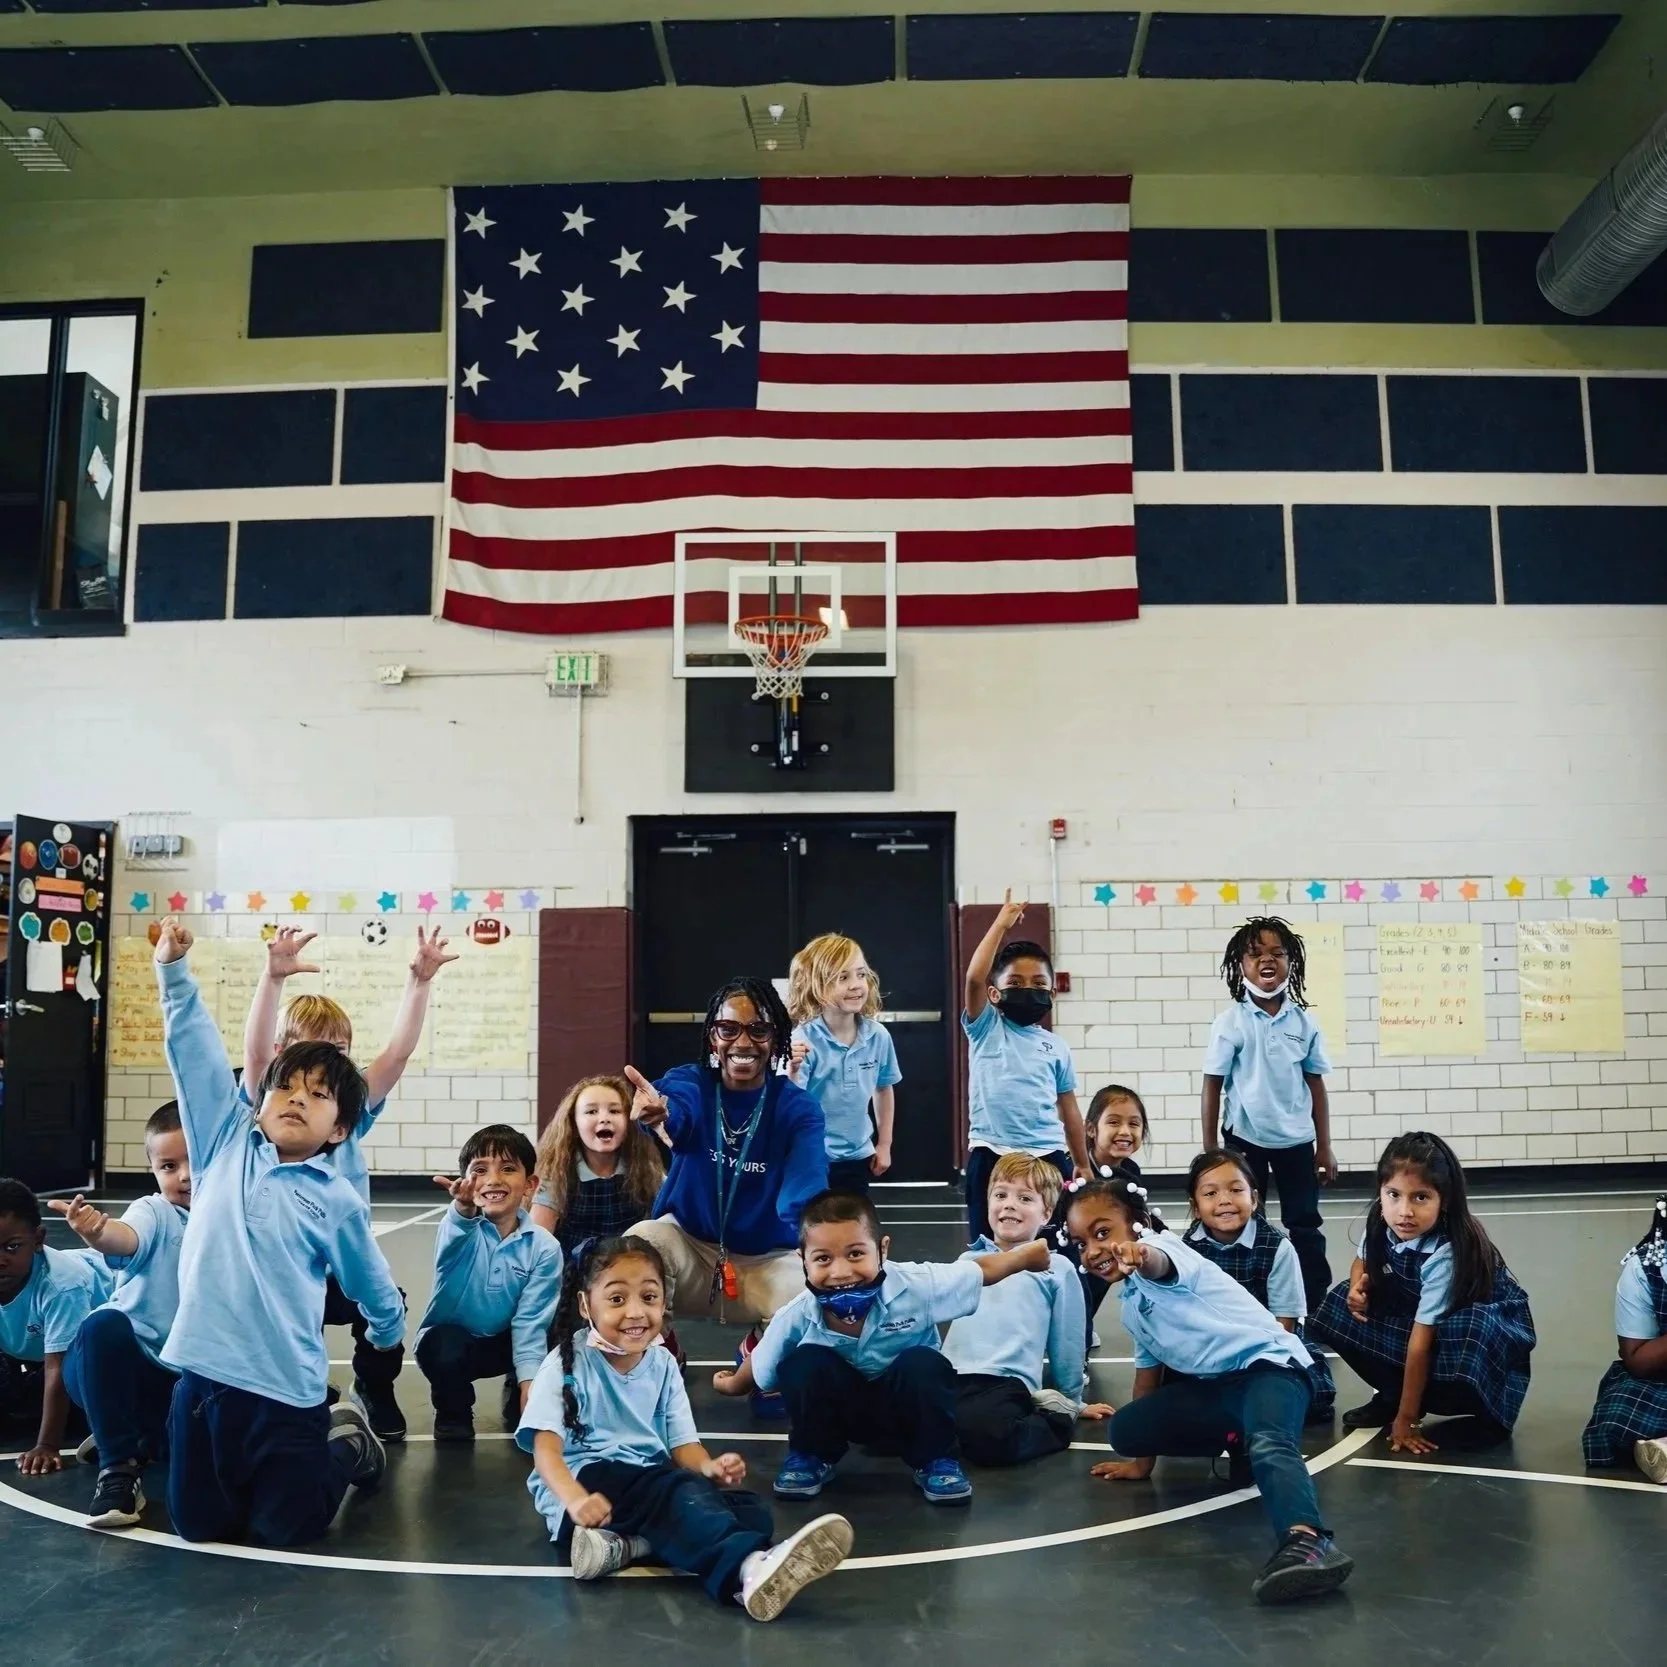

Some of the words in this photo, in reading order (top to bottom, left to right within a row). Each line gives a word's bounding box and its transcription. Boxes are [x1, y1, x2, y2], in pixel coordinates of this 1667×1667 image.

[557, 655, 592, 680] EXIT
[1379, 925, 1410, 938] Grades
[1552, 922, 1578, 936] School
[1584, 922, 1613, 936] Grades
[1524, 1011, 1533, 1021] F
[1542, 1011, 1553, 1022] 59
